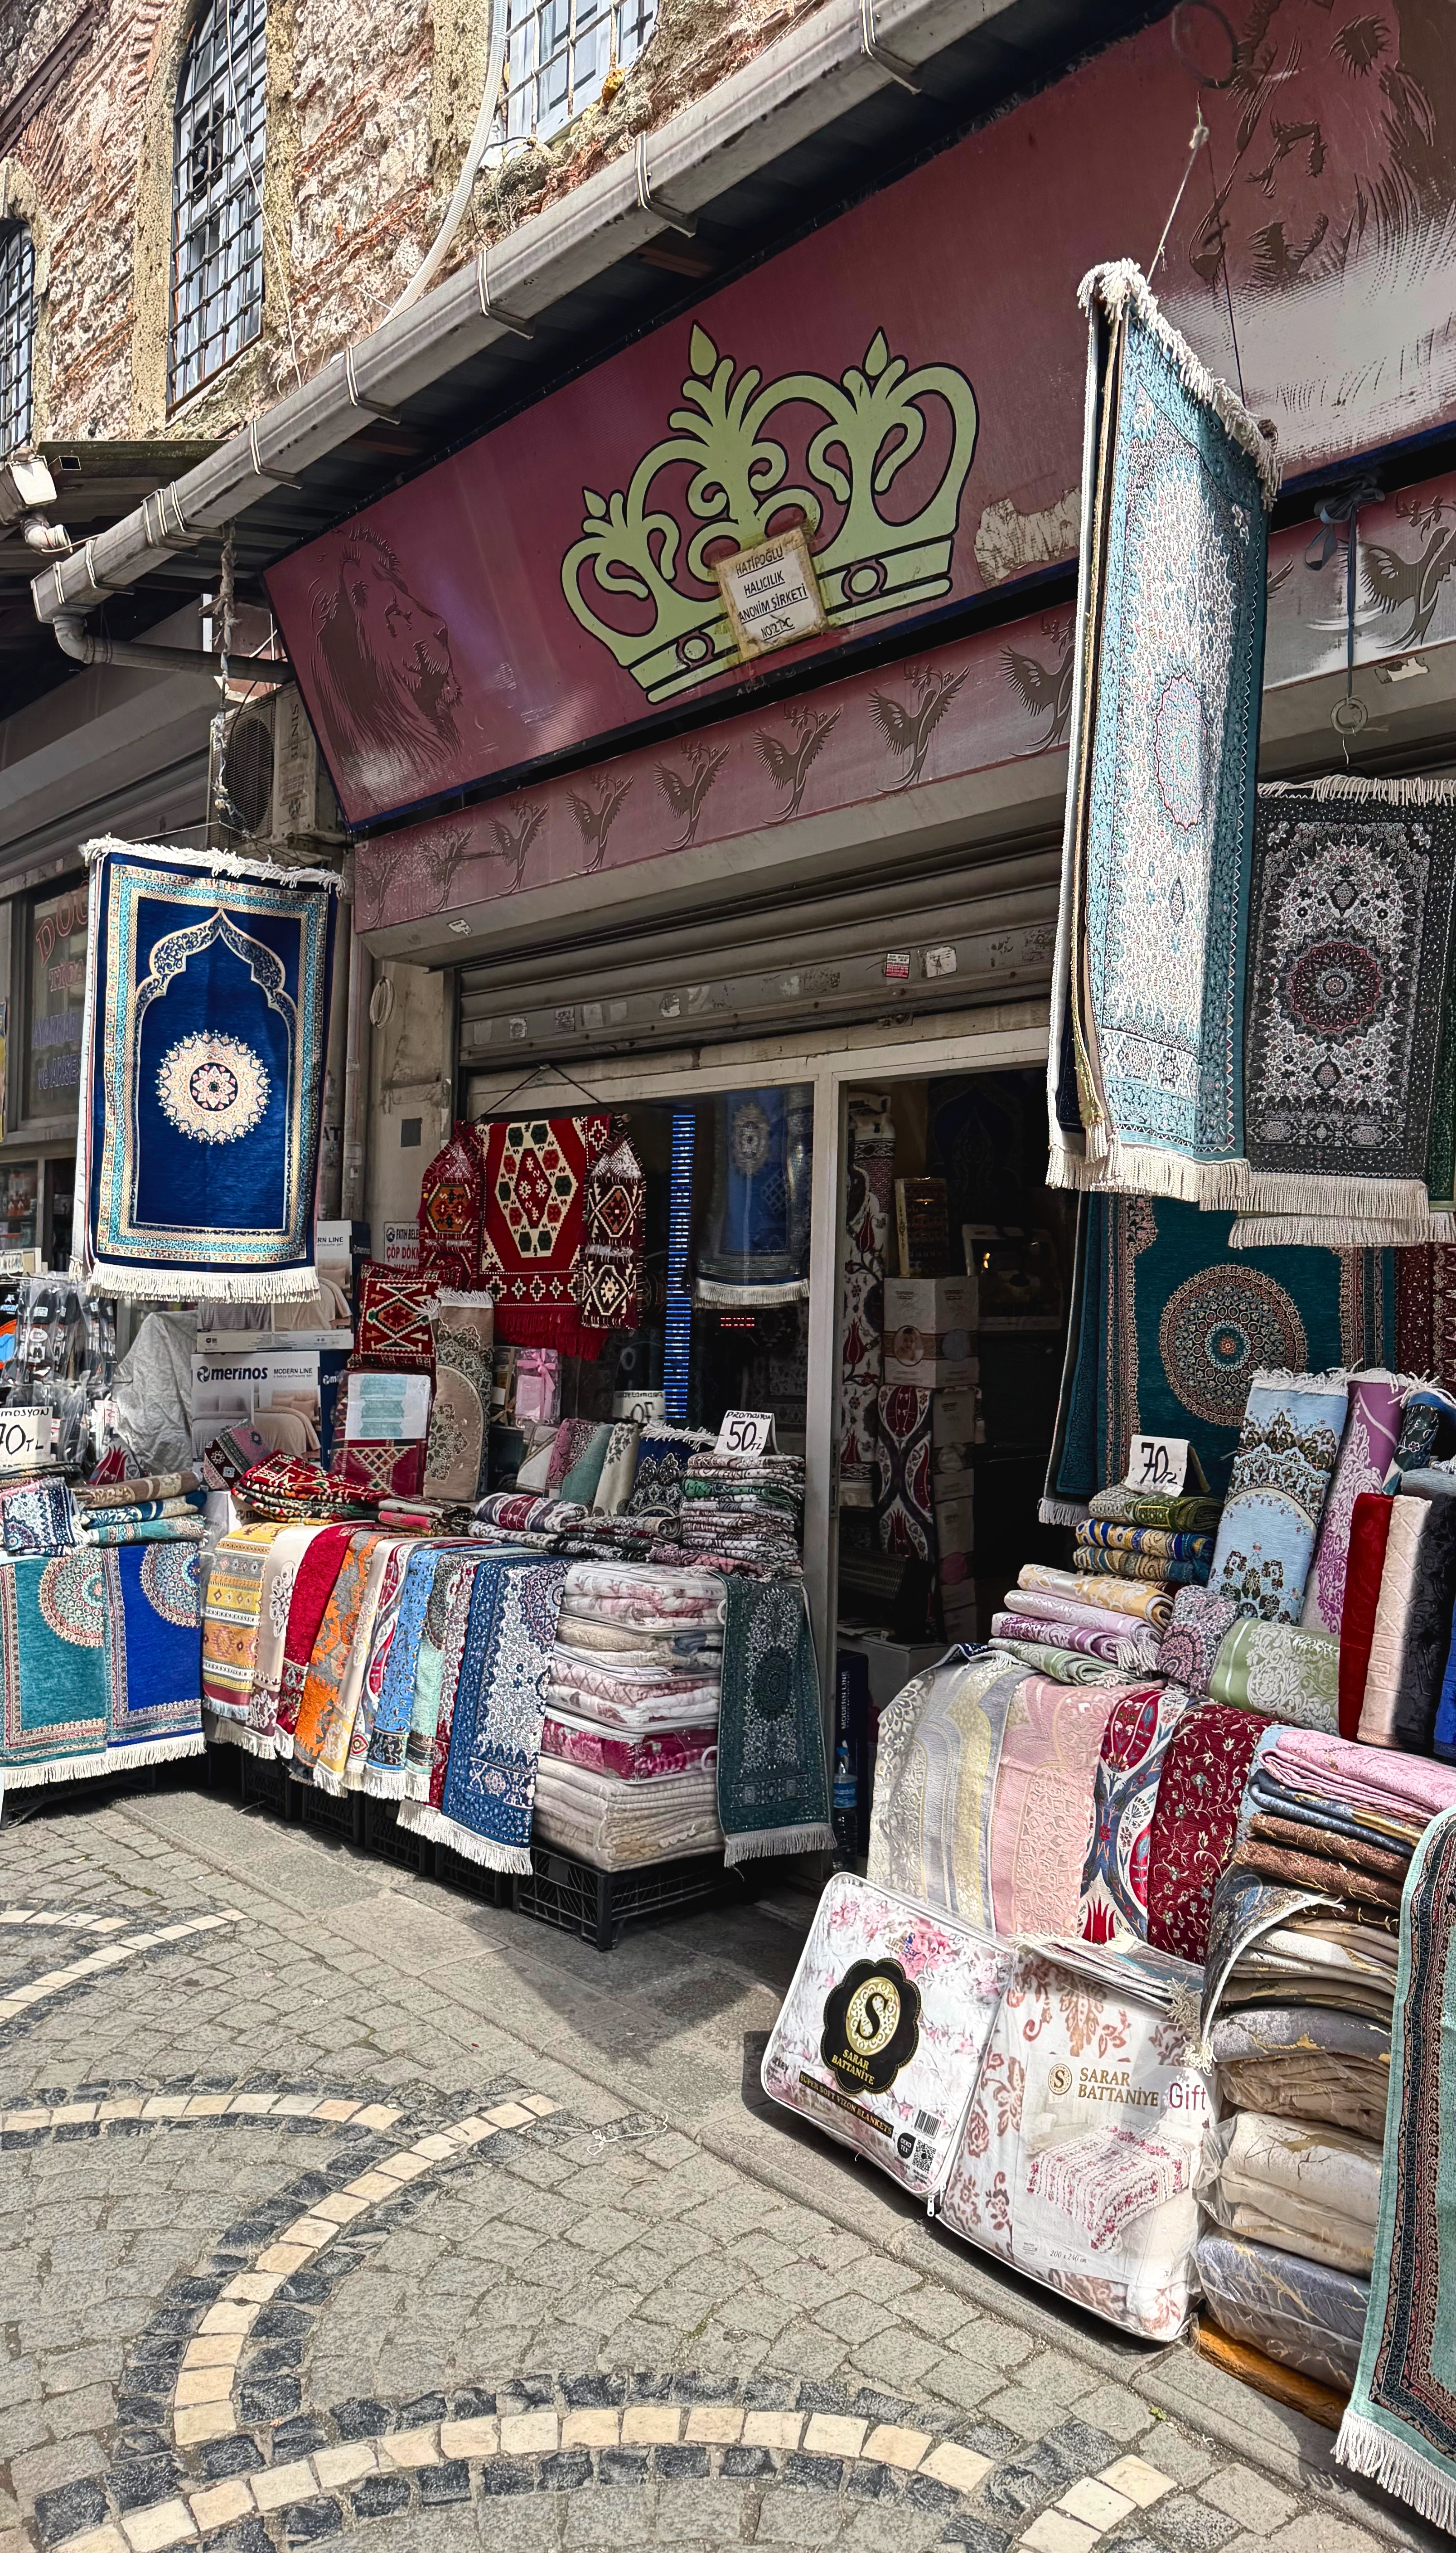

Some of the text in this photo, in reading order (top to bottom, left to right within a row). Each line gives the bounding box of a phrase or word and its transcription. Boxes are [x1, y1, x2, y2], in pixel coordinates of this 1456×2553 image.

[735, 545, 783, 575] HATİPOĞLU
[744, 570, 784, 595] HALICILIK
[739, 583, 808, 622] ANONİM ŞİRKETİ
[387, 1244, 400, 1262] ÇÖP
[211, 1367, 268, 1380] merinos
[726, 1421, 757, 1451] 50
[855, 1992, 890, 2039] S
[831, 2054, 875, 2085] BATTANİYE
[842, 2049, 870, 2070] SARAR
[1054, 2069, 1065, 2088] S
[1080, 2068, 1130, 2087] SARAR
[800, 2074, 819, 2090] SUPER
[819, 2085, 835, 2099] SOFT
[837, 2095, 857, 2113] VIZON
[856, 2110, 892, 2135] BLANKETS
[1078, 2083, 1159, 2106] BATTANİYE
[1169, 2082, 1206, 2110] Gift
[1050, 2250, 1062, 2258] 200
